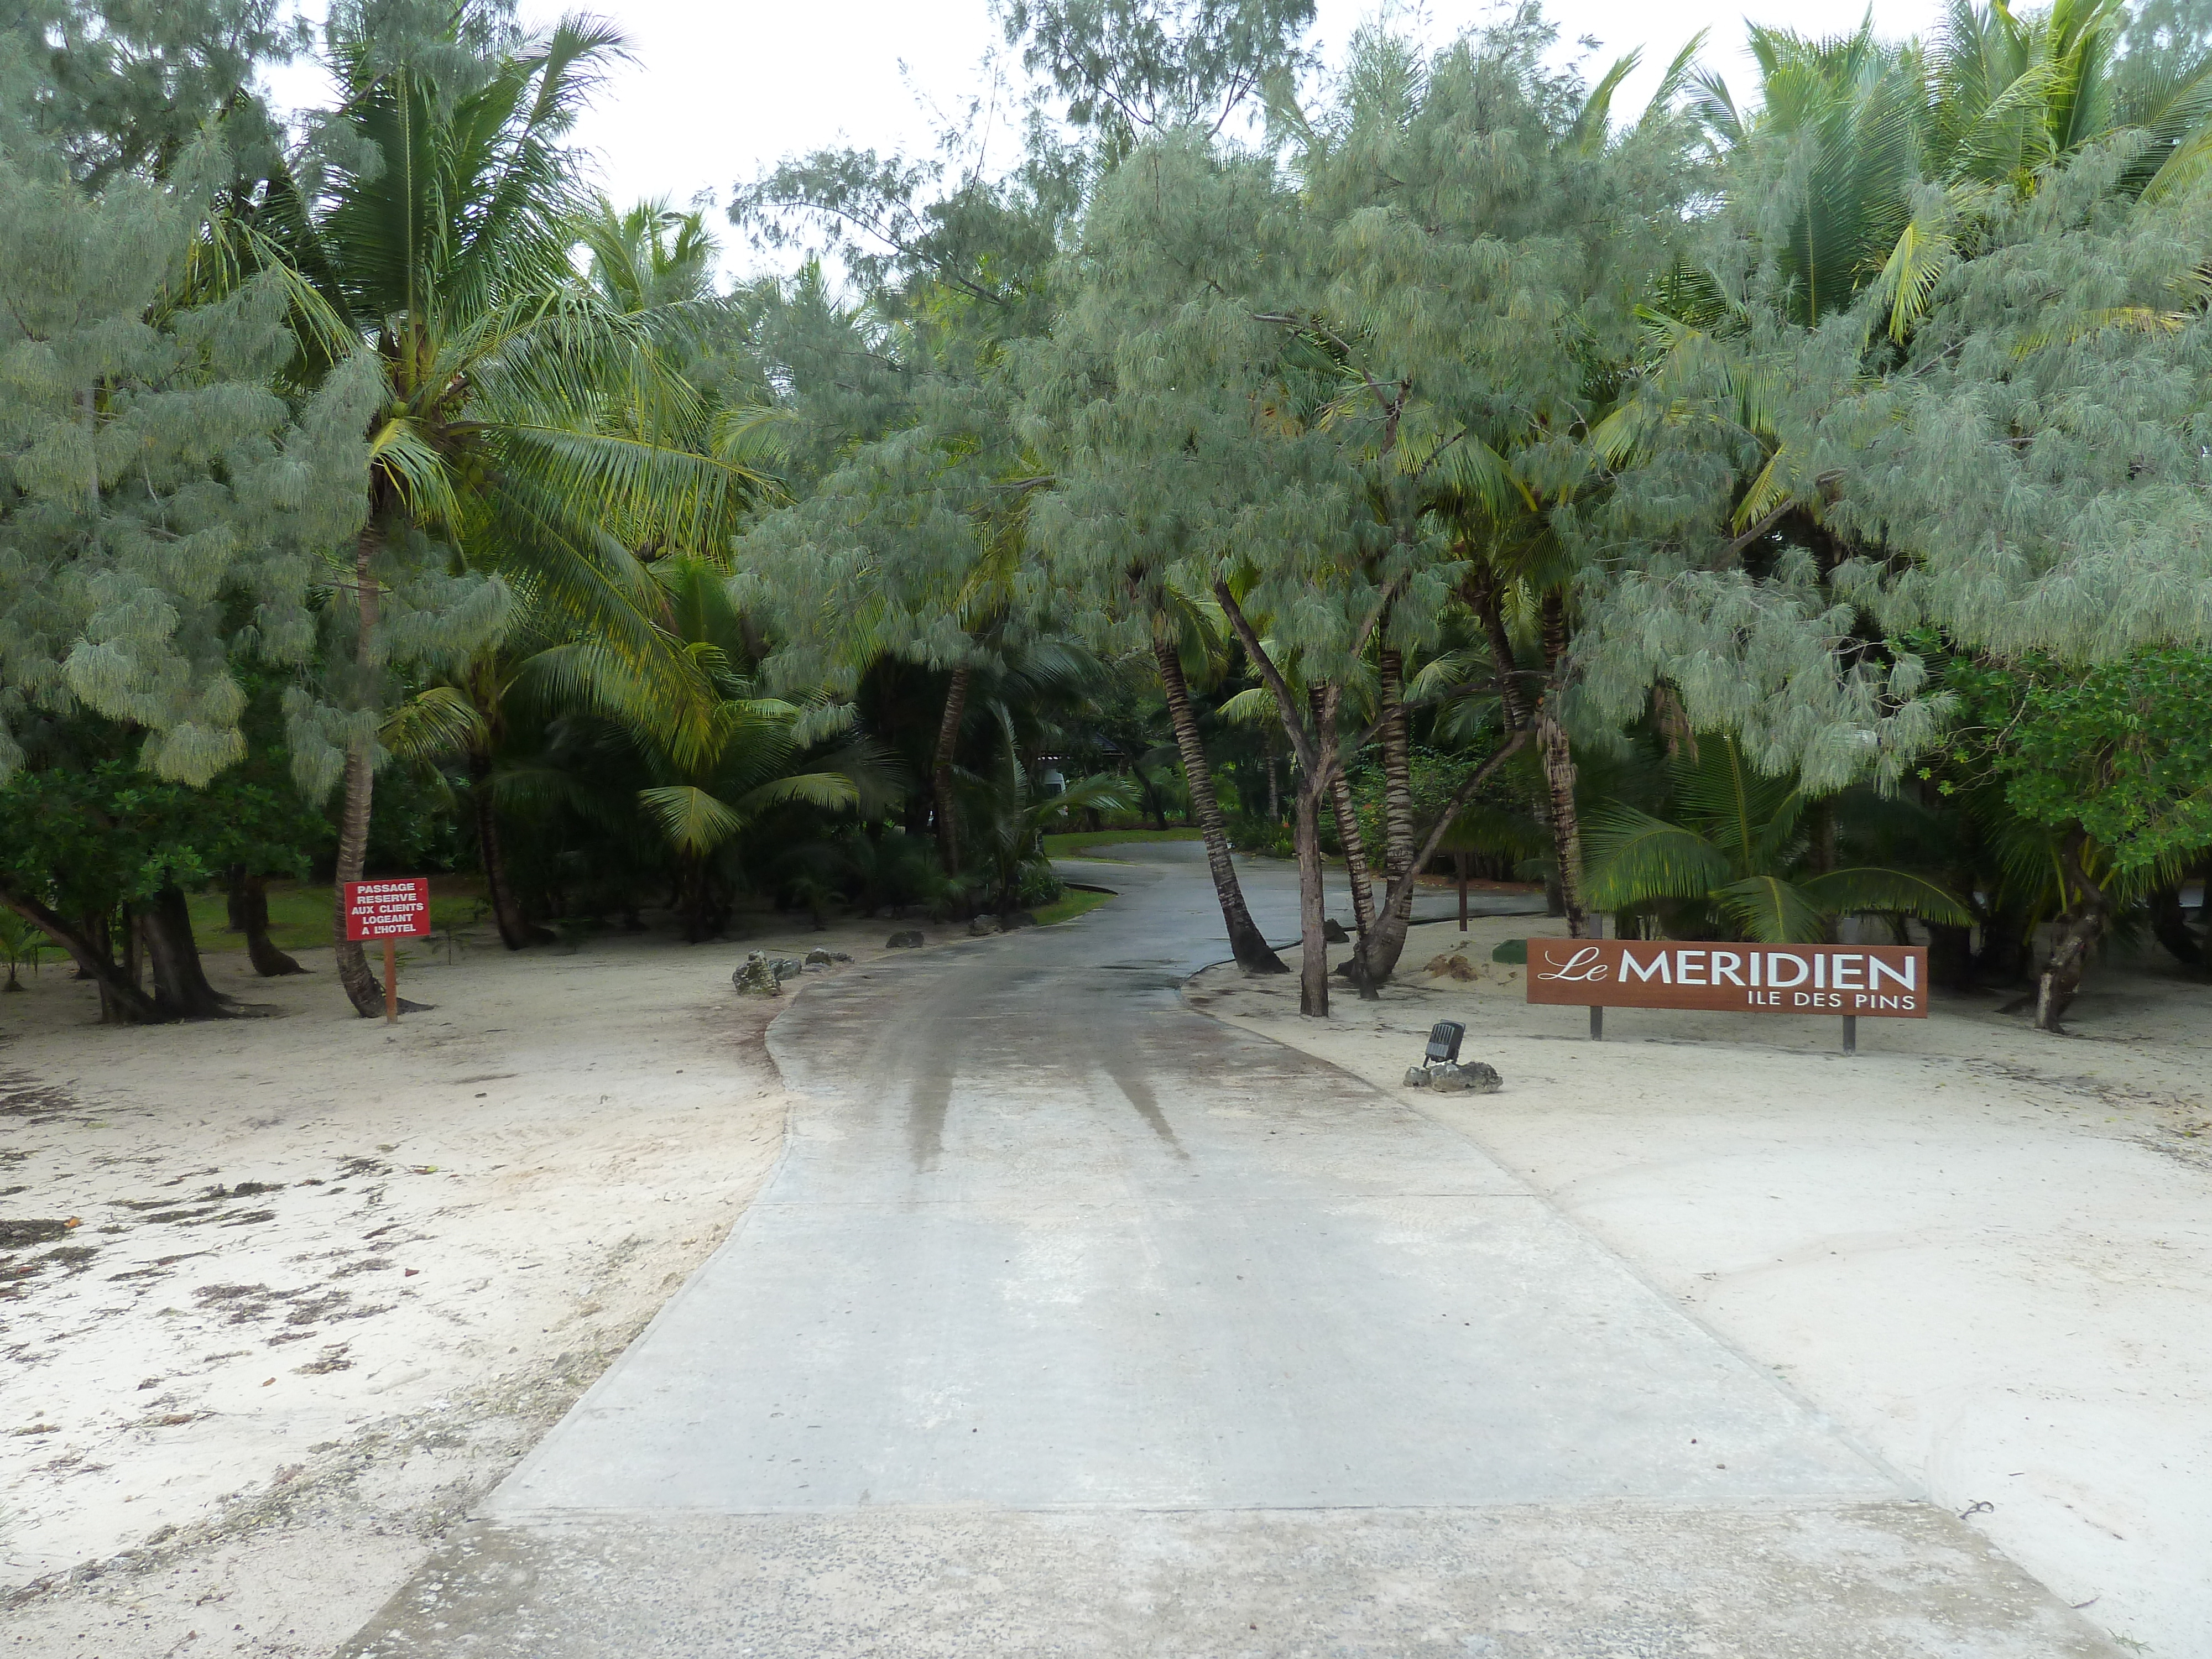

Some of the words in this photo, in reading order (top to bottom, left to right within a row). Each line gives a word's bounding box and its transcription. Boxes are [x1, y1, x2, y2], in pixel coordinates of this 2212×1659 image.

[357, 883, 415, 894] PASSAGE
[357, 893, 416, 904] RESERVE
[352, 906, 374, 915] AUX
[379, 903, 424, 913] CLIENTS
[363, 914, 413, 924] LOGEANT
[374, 924, 416, 934] L'HOTEL
[1537, 946, 1608, 982] Le
[1618, 948, 1915, 991] MERIDIEN
[1748, 990, 1781, 1005] ILE
[1794, 992, 1842, 1007] DES
[1855, 994, 1915, 1010] PINS
